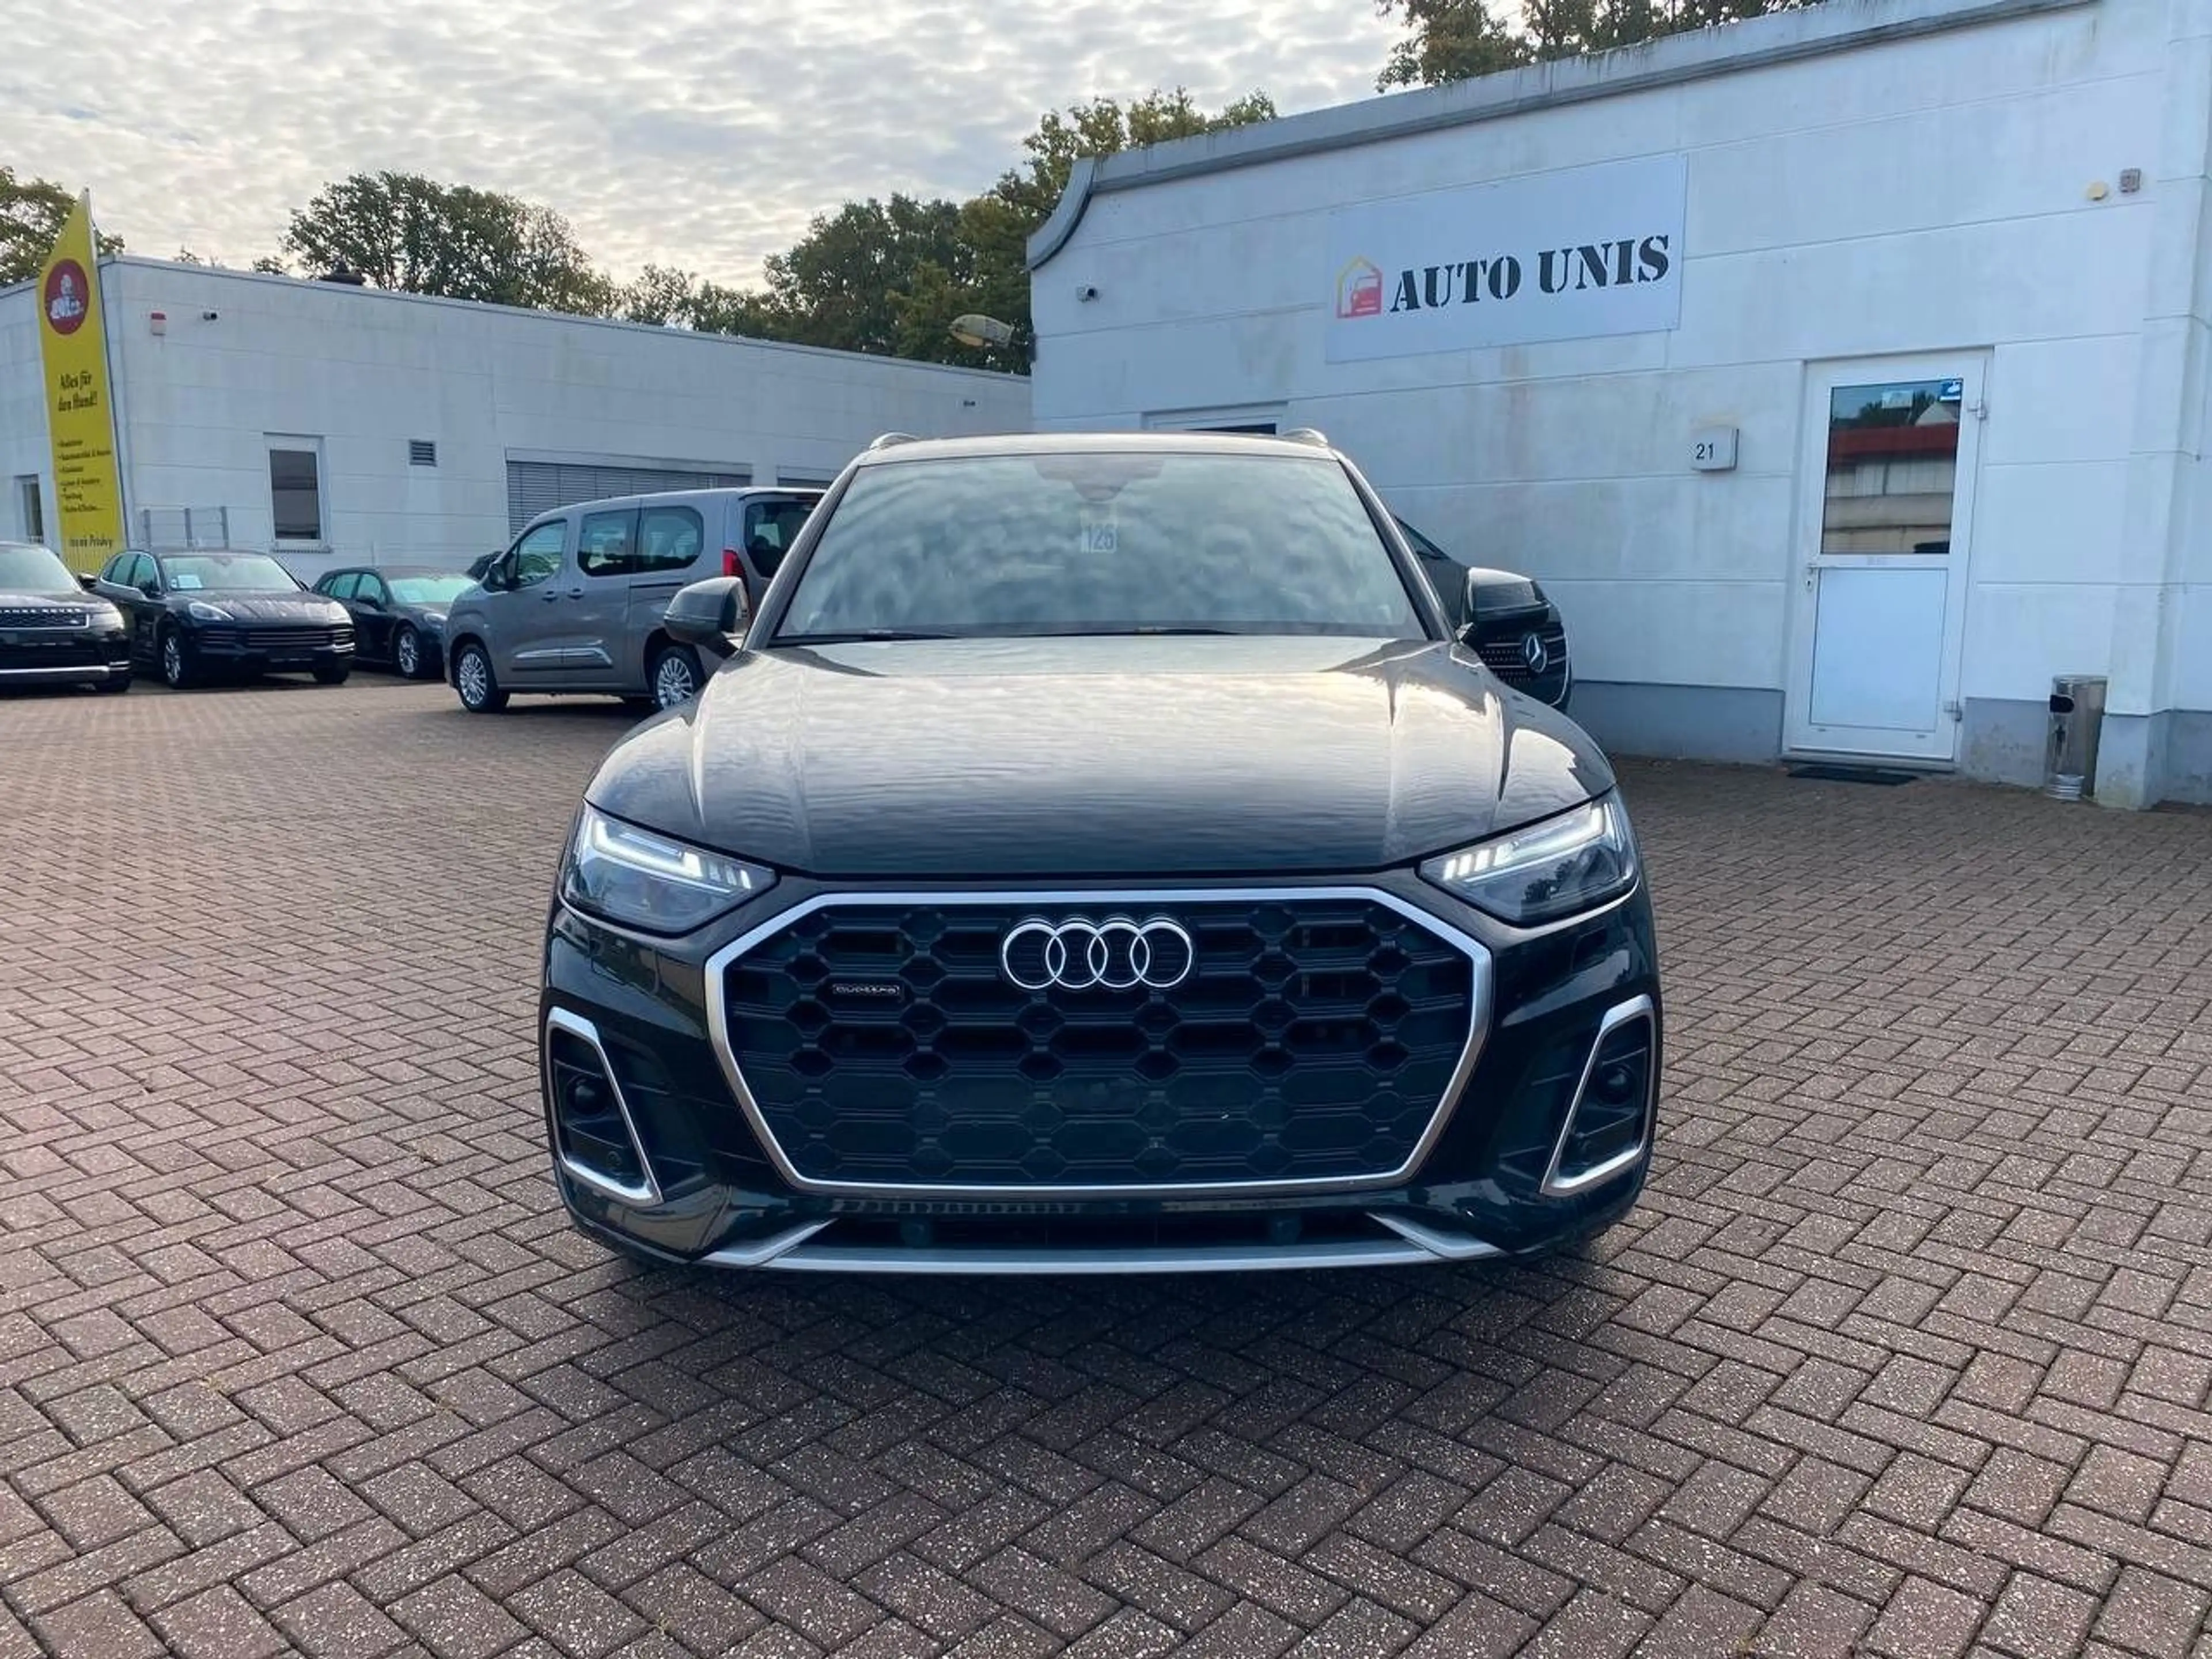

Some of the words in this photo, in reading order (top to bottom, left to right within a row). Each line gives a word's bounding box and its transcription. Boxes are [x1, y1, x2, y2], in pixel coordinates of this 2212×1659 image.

[1389, 255, 1521, 313] AUTO
[1537, 234, 1669, 294] UNIS
[1695, 442, 1713, 460] 21
